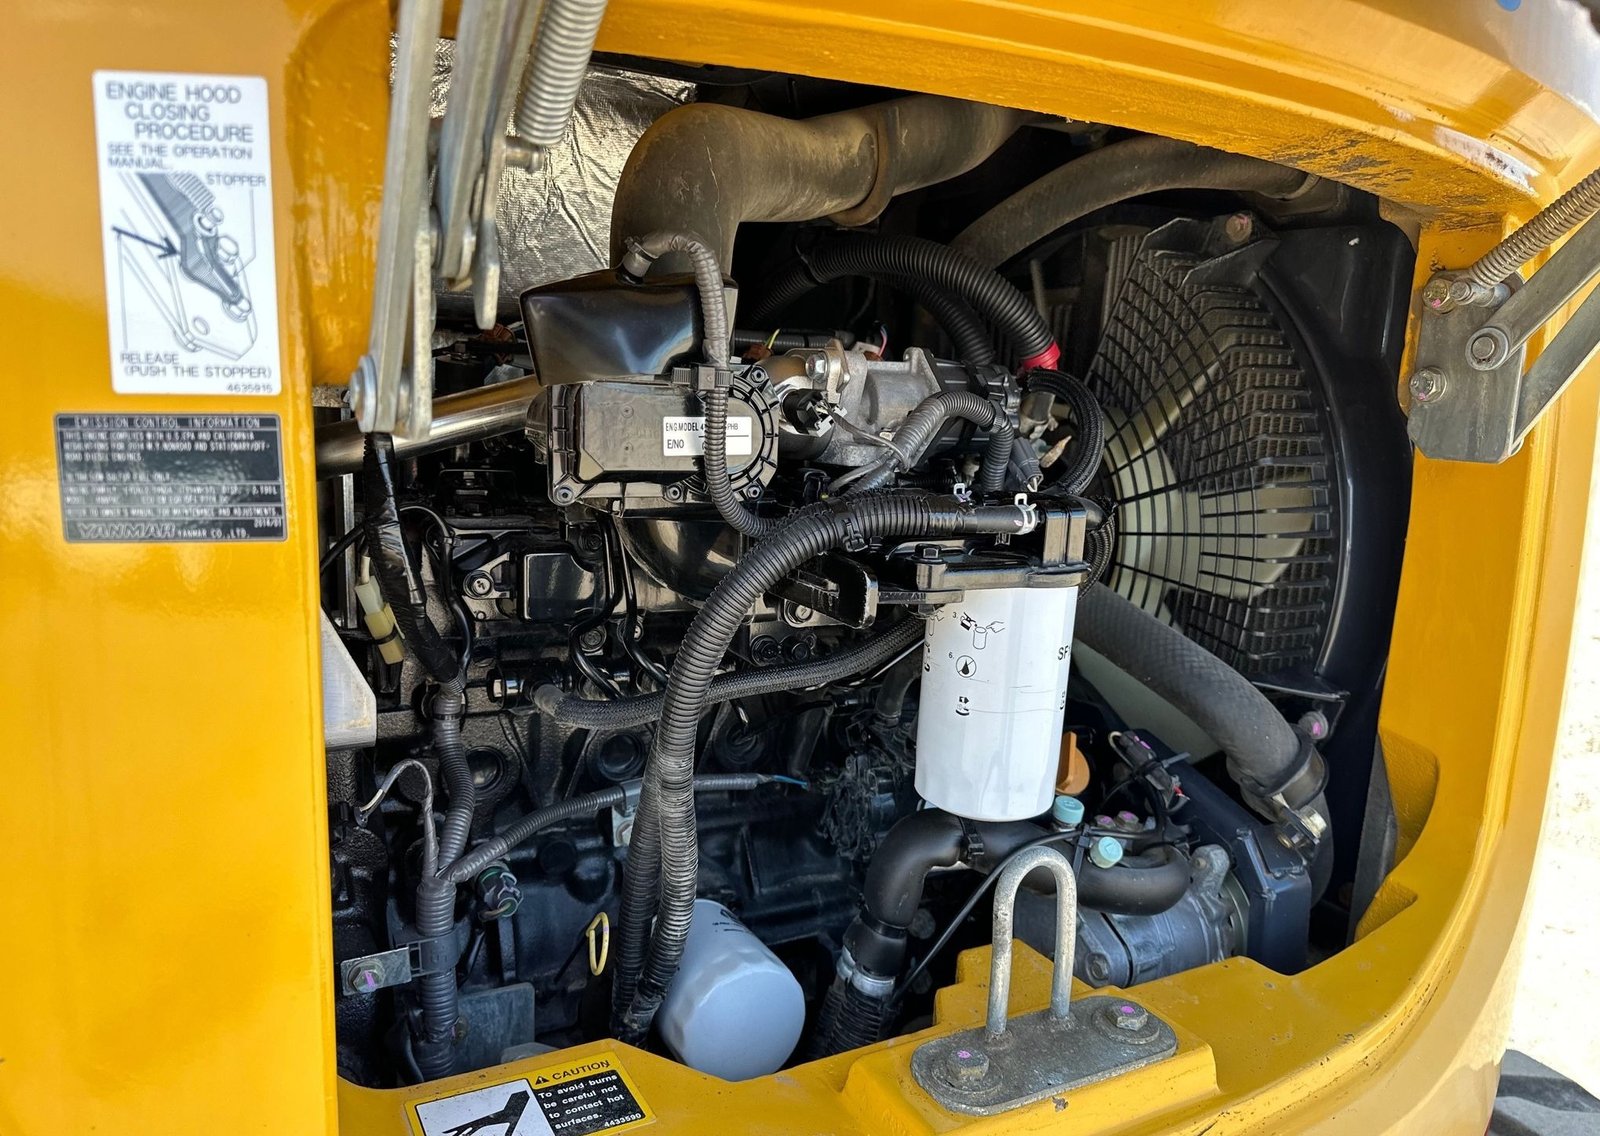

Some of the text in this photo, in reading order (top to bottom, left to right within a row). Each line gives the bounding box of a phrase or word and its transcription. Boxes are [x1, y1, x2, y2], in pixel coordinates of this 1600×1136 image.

[106, 81, 242, 104] ENGINE HOOD
[124, 102, 211, 122] CLOSING
[135, 122, 254, 143] PROCEDURE
[107, 142, 253, 160] SEE THE OPERATION
[206, 173, 267, 187] STOPPER
[120, 352, 180, 365] RELEASE
[124, 365, 272, 379] (PUSH THE STOPPER)
[74, 416, 261, 429] EMISSION CONTROL INFORMATION
[665, 422, 699, 431] ENG.MODEL
[667, 439, 685, 449] E/NO
[178, 530, 207, 538] YANMAR
[552, 1060, 611, 1080] CAUTION
[557, 1082, 585, 1095] avoid
[588, 1074, 618, 1086] burns
[543, 1085, 618, 1109] be careful not
[565, 1099, 603, 1115] contact
[607, 1093, 625, 1103] hot
[554, 1113, 603, 1130] surfaces.
[604, 1112, 642, 1127] 4433590
